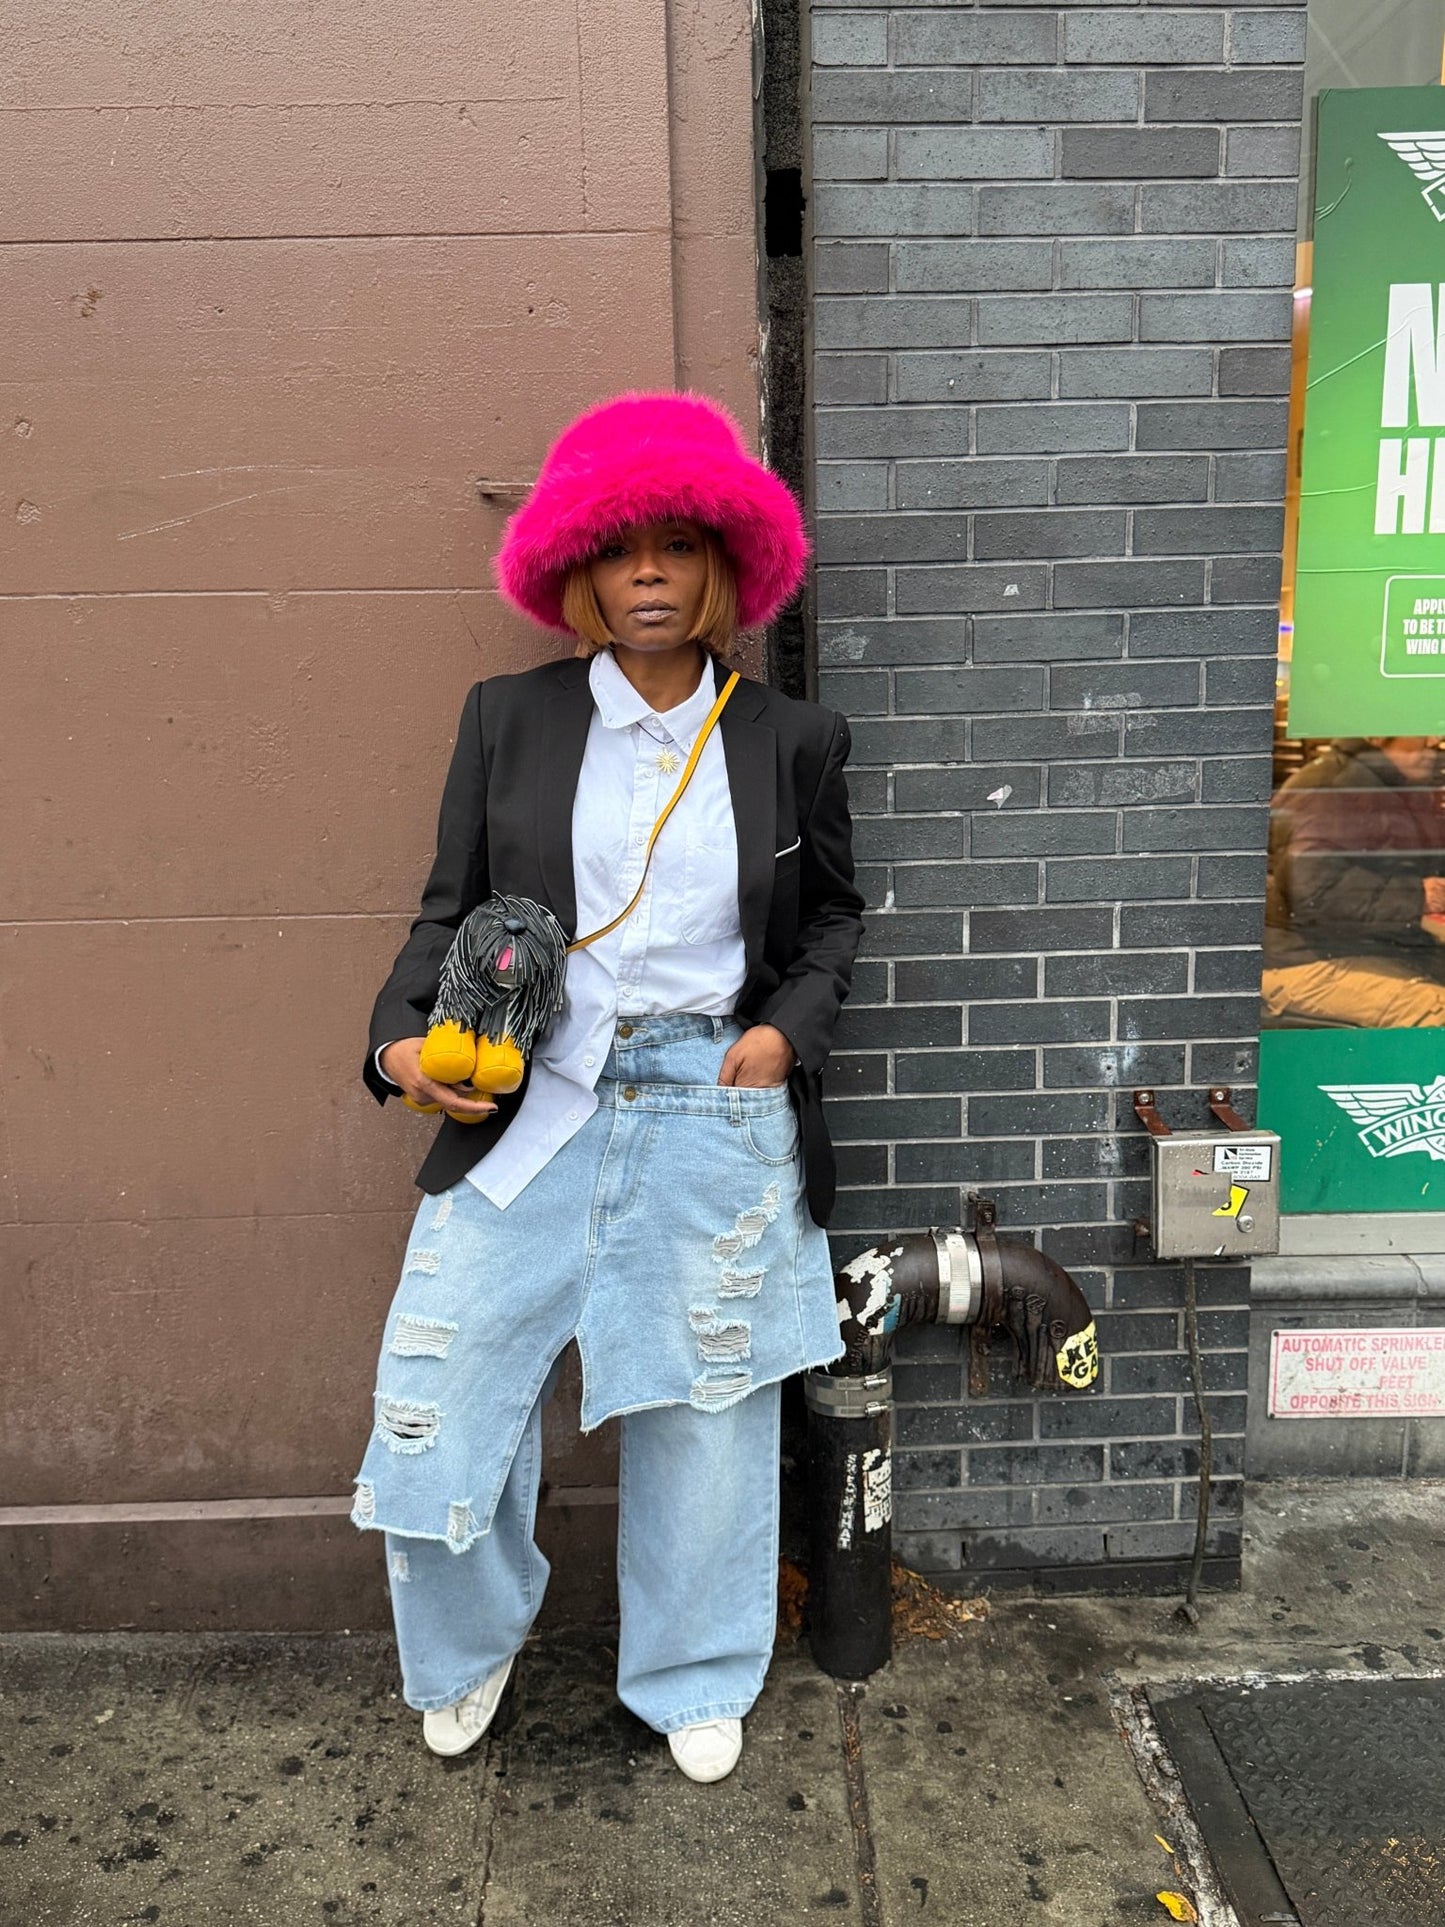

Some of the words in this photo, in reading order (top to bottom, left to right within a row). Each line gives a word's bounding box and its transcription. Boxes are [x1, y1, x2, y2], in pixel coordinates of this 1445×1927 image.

[1403, 619, 1418, 635] TO
[1419, 619, 1435, 635] BE
[1406, 638, 1439, 655] WING
[1282, 1338, 1366, 1352] AUTOMATIC
[1371, 1336, 1445, 1351] SPRINKLE
[1305, 1357, 1344, 1371] SHUT
[1349, 1357, 1376, 1371] OFF
[1381, 1356, 1427, 1371] VALVE
[1379, 1375, 1415, 1389] FEET
[1290, 1395, 1361, 1409] OPPOSITE
[1367, 1394, 1398, 1408] THIS
[1403, 1394, 1438, 1408] SIGN
